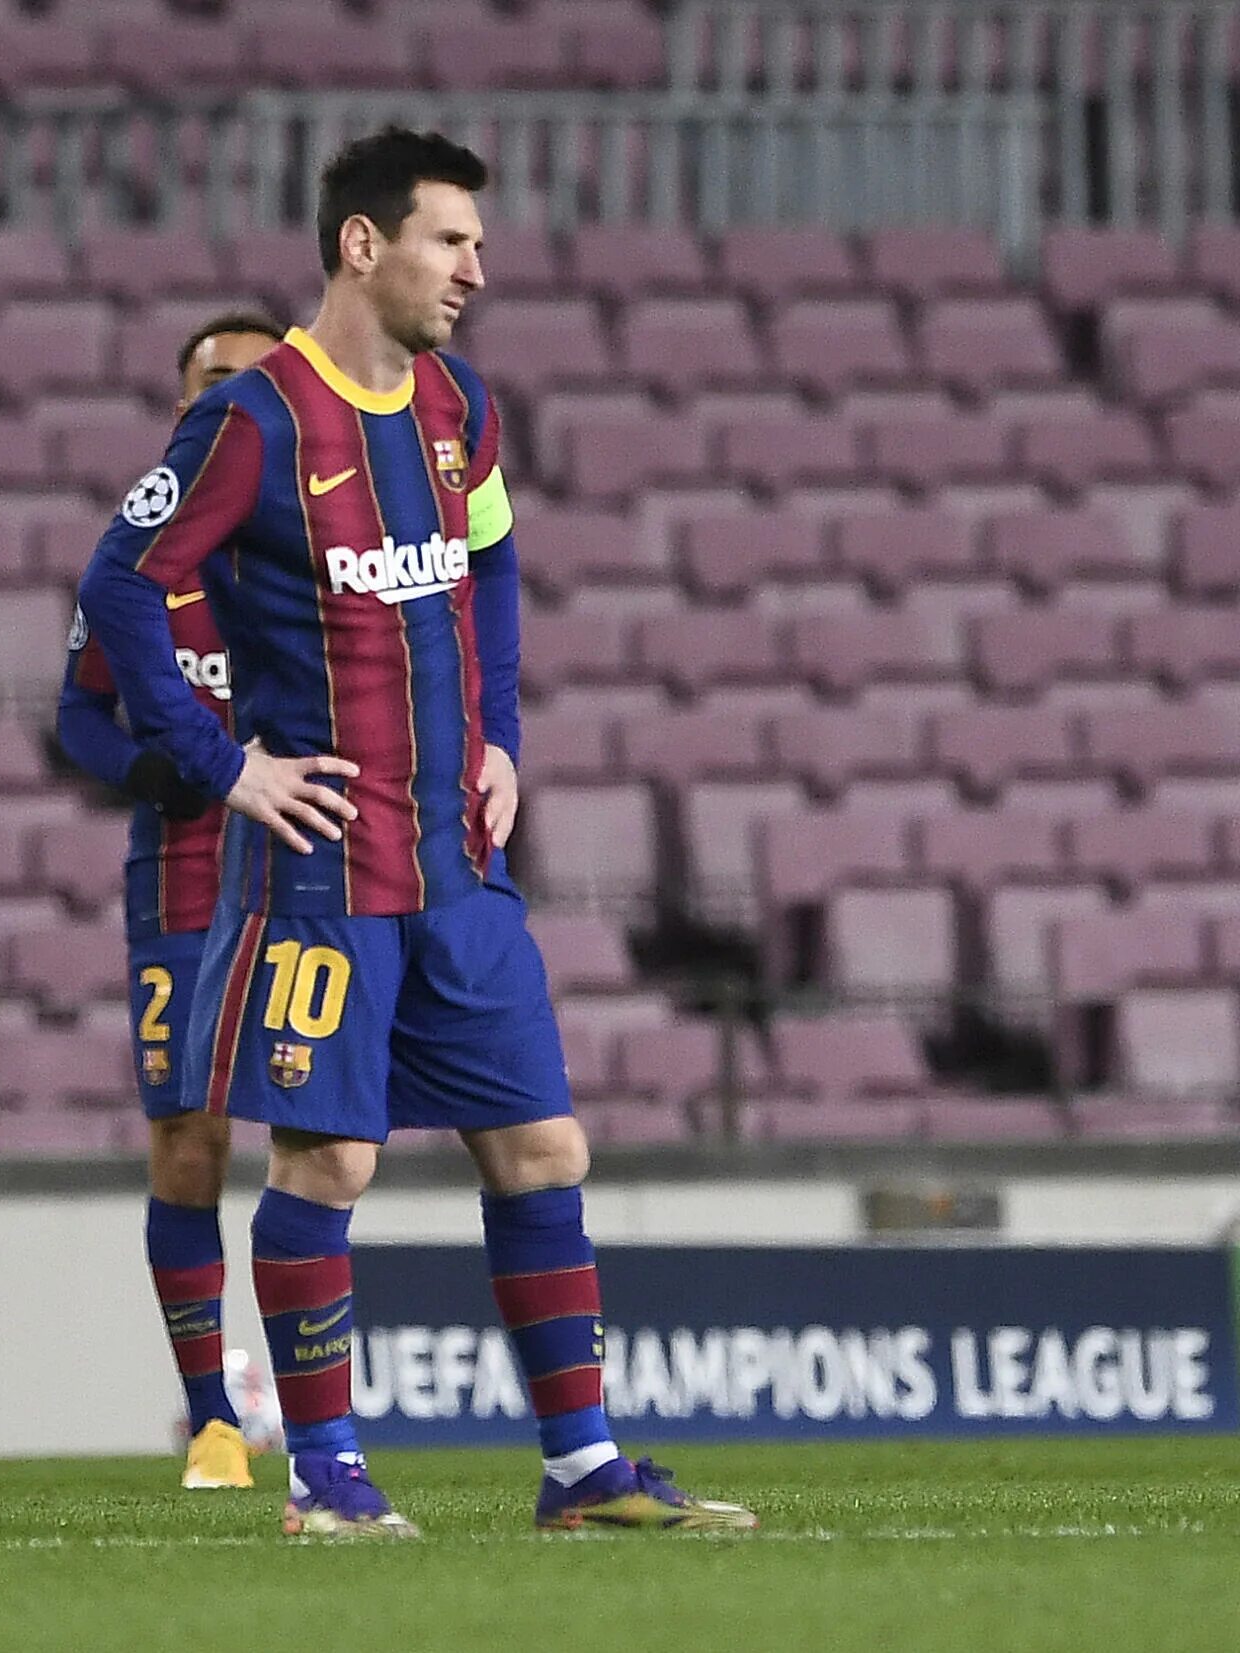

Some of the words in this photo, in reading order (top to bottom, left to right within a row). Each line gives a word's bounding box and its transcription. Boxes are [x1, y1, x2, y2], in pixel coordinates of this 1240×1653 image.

[175, 648, 231, 689] Ra
[139, 966, 173, 1042] 2
[264, 941, 352, 1039] 10
[351, 1325, 528, 1418] UEFA
[602, 1325, 938, 1420] HAMPIONS
[951, 1325, 1214, 1419] LEAGUE
